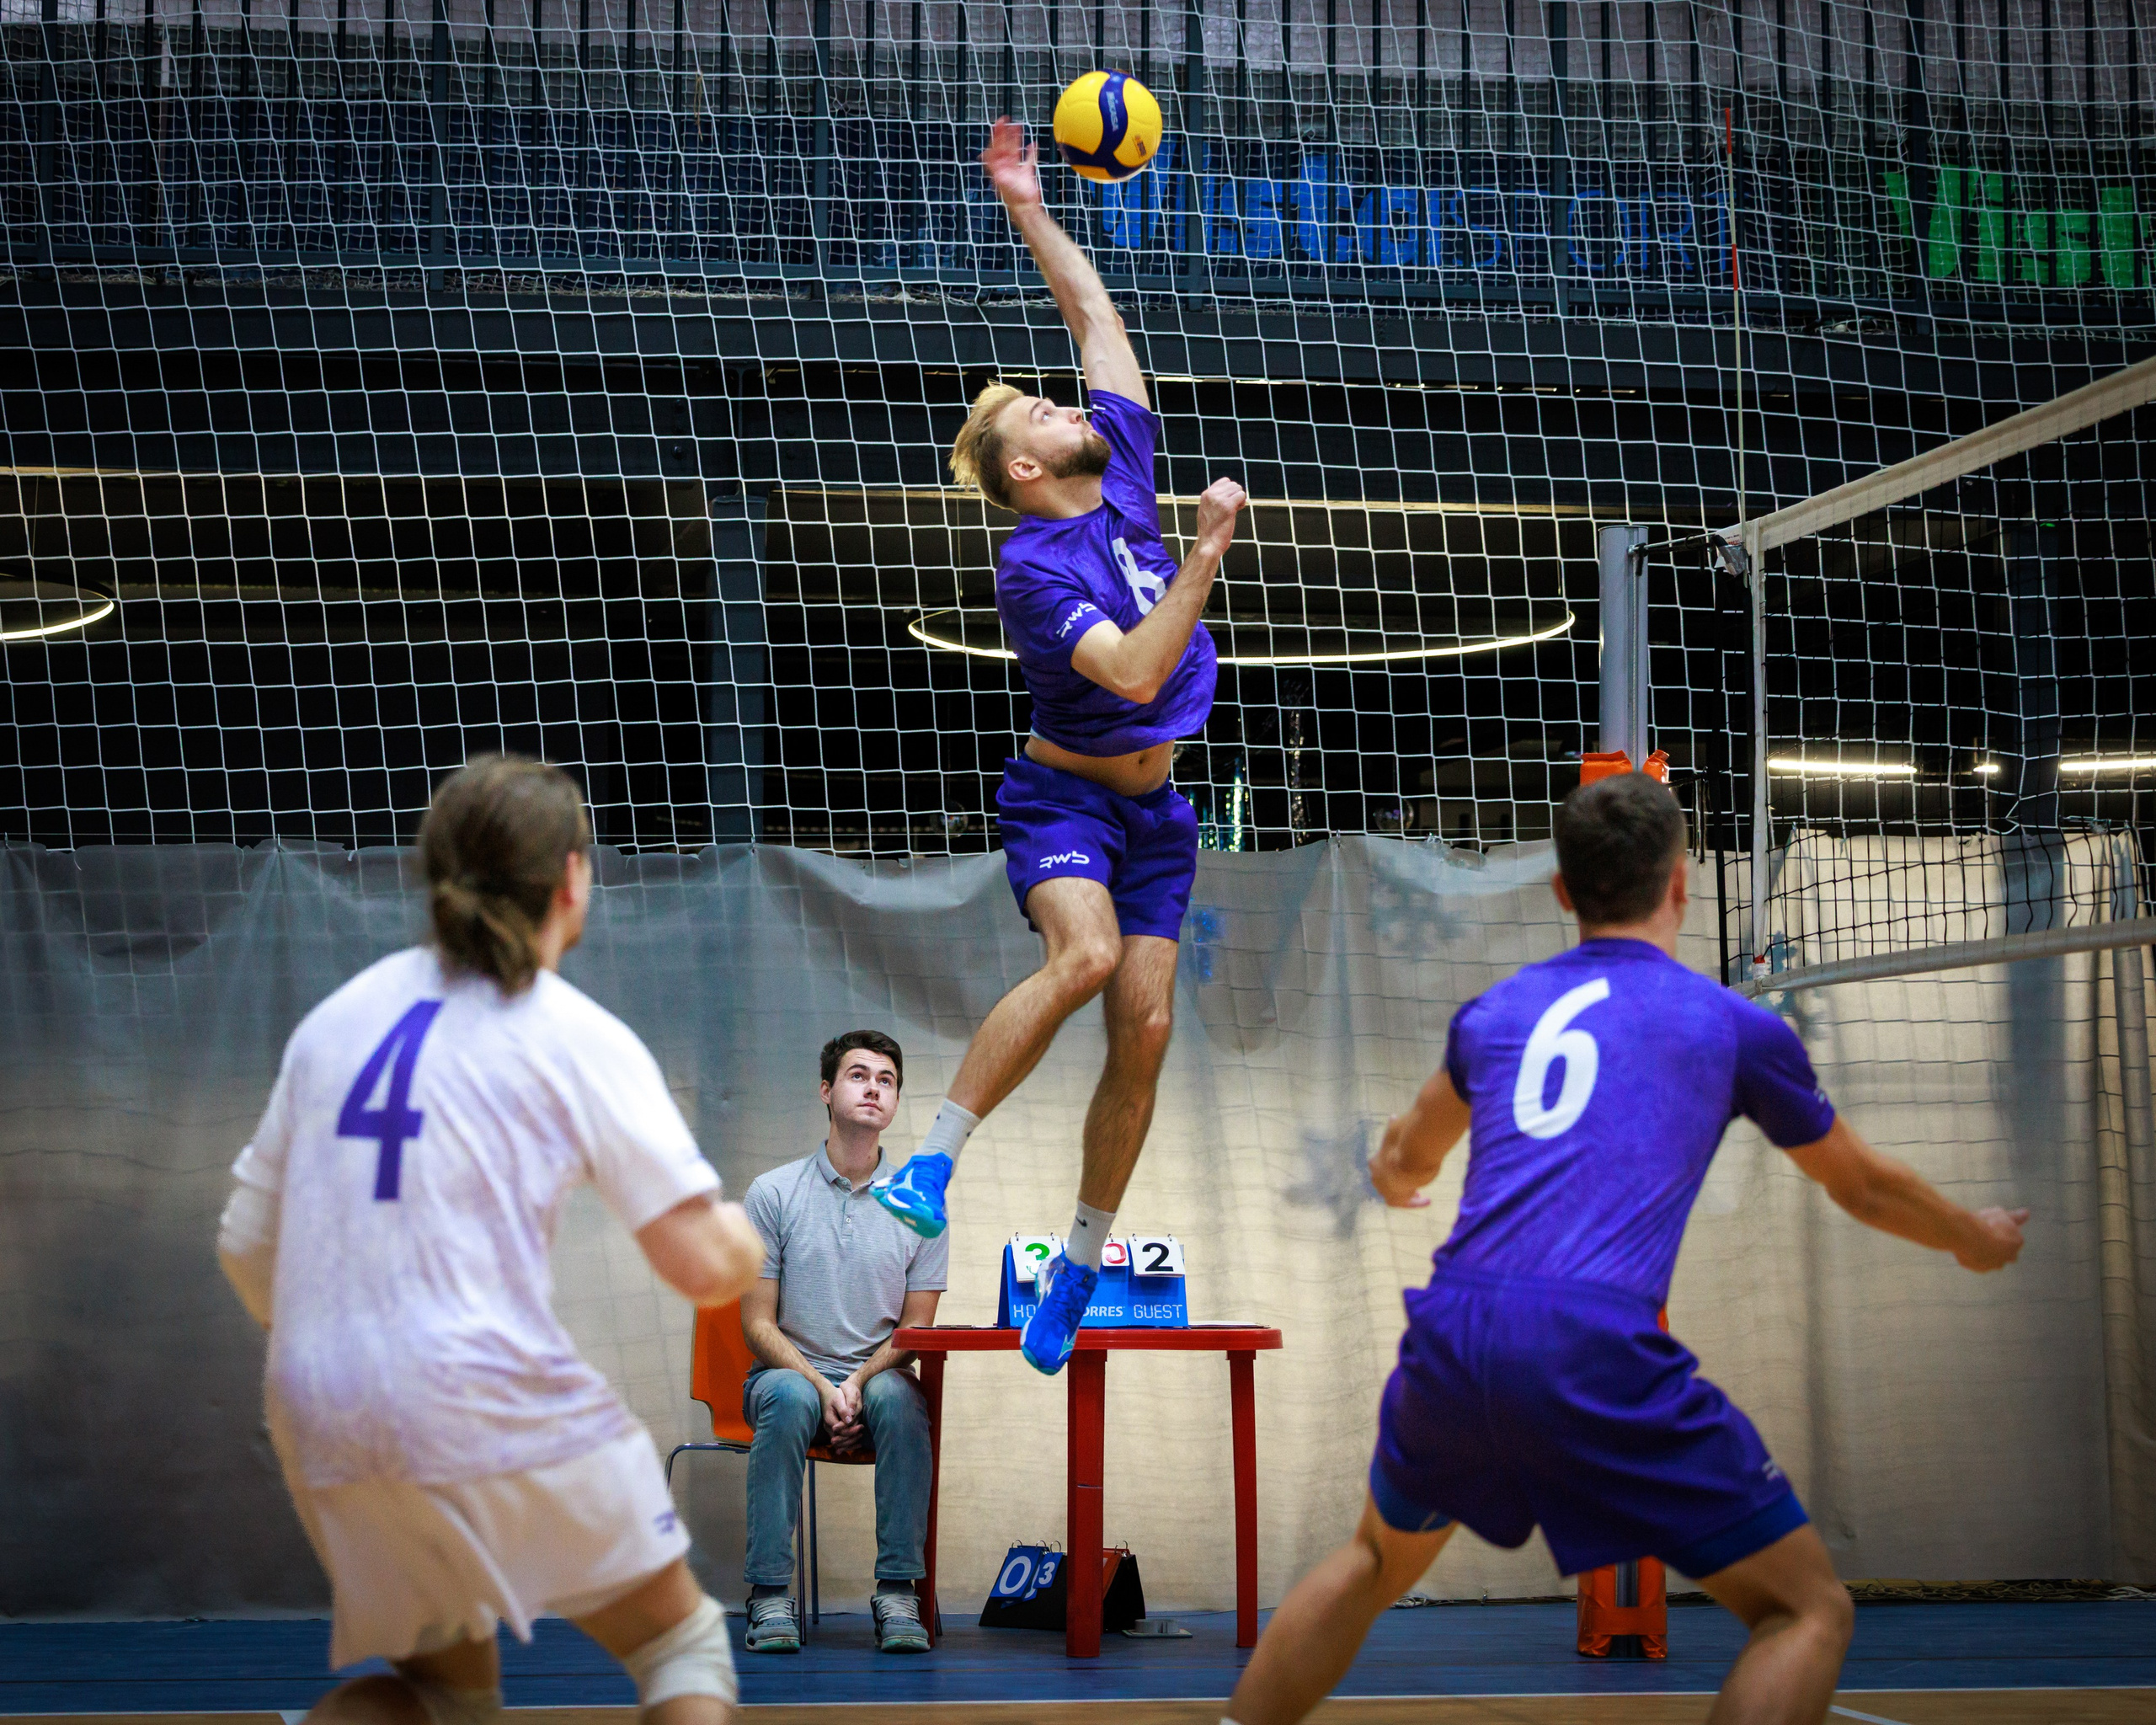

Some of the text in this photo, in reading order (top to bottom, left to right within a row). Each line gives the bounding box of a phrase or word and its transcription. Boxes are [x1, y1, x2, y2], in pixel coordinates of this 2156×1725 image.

[1882, 164, 2156, 288] Vist
[1513, 976, 1610, 1140] 6
[336, 1000, 443, 1200] 4
[1025, 1242, 1050, 1275] 3
[1142, 1242, 1174, 1272] 2
[1013, 1305, 1182, 1319] HO ORRES GUEST
[999, 1555, 1032, 1594] 0
[1038, 1562, 1055, 1584] 3
